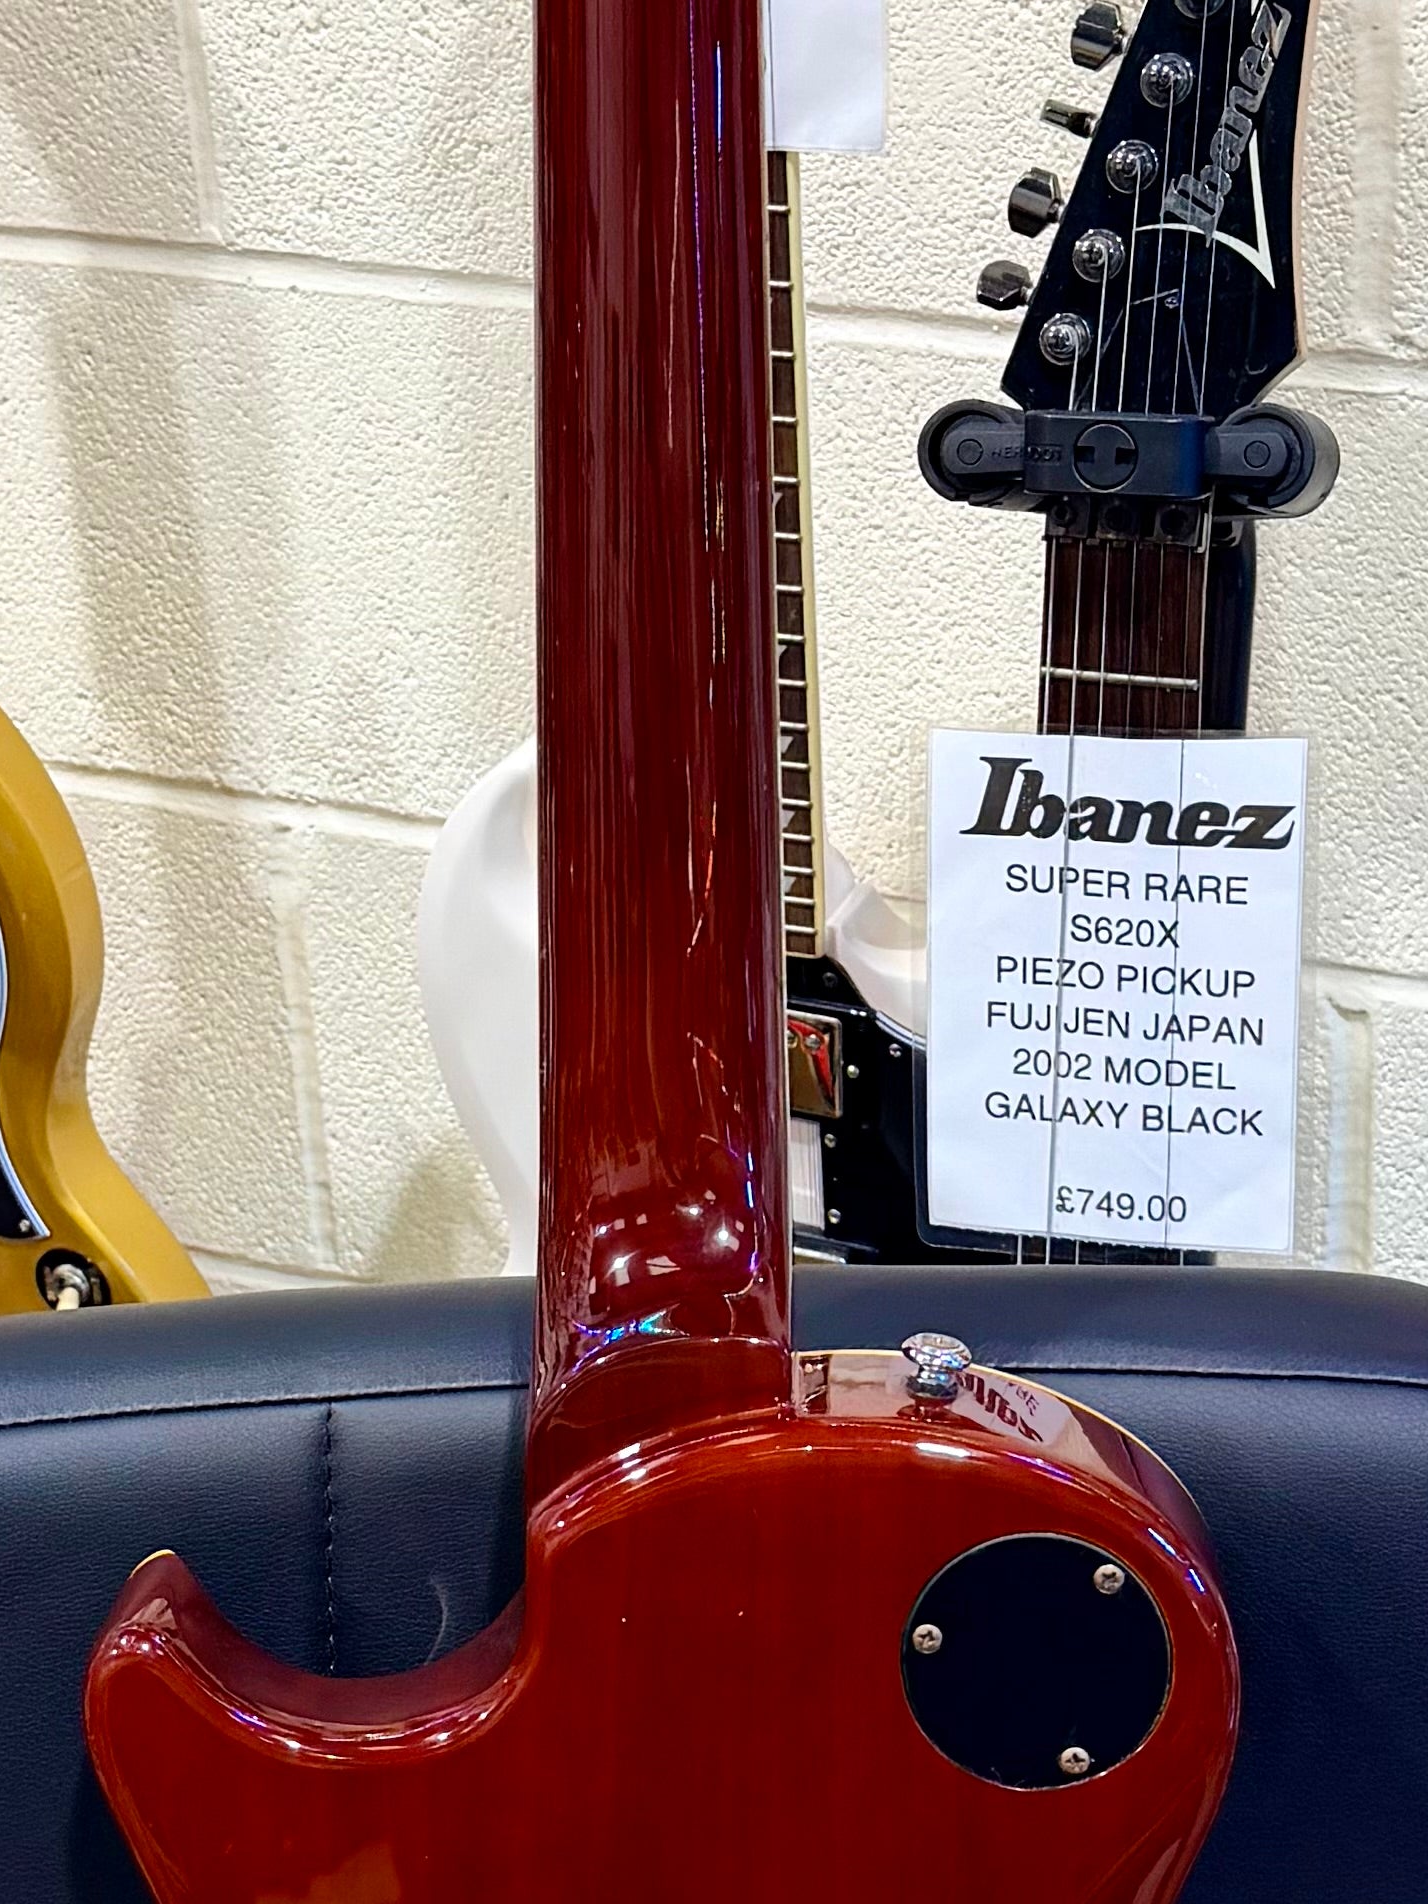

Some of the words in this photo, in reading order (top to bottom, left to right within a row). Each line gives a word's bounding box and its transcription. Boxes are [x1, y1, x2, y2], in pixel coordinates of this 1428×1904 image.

[1161, 0, 1292, 248] Ibanez
[959, 756, 1296, 850] Ibanez
[1005, 864, 1131, 899] SUPER
[1144, 872, 1249, 905] RARE
[1070, 914, 1180, 948] S620X
[996, 956, 1104, 990] PIEZO
[1117, 965, 1256, 998] PICKUP
[1143, 1013, 1264, 1046] JAPAN
[1012, 1049, 1092, 1081] 2002
[1104, 1058, 1236, 1090] MODEL
[984, 1091, 1130, 1129] GALAXY
[1142, 1104, 1264, 1136] BLACK
[1055, 1185, 1187, 1223] £749.00
